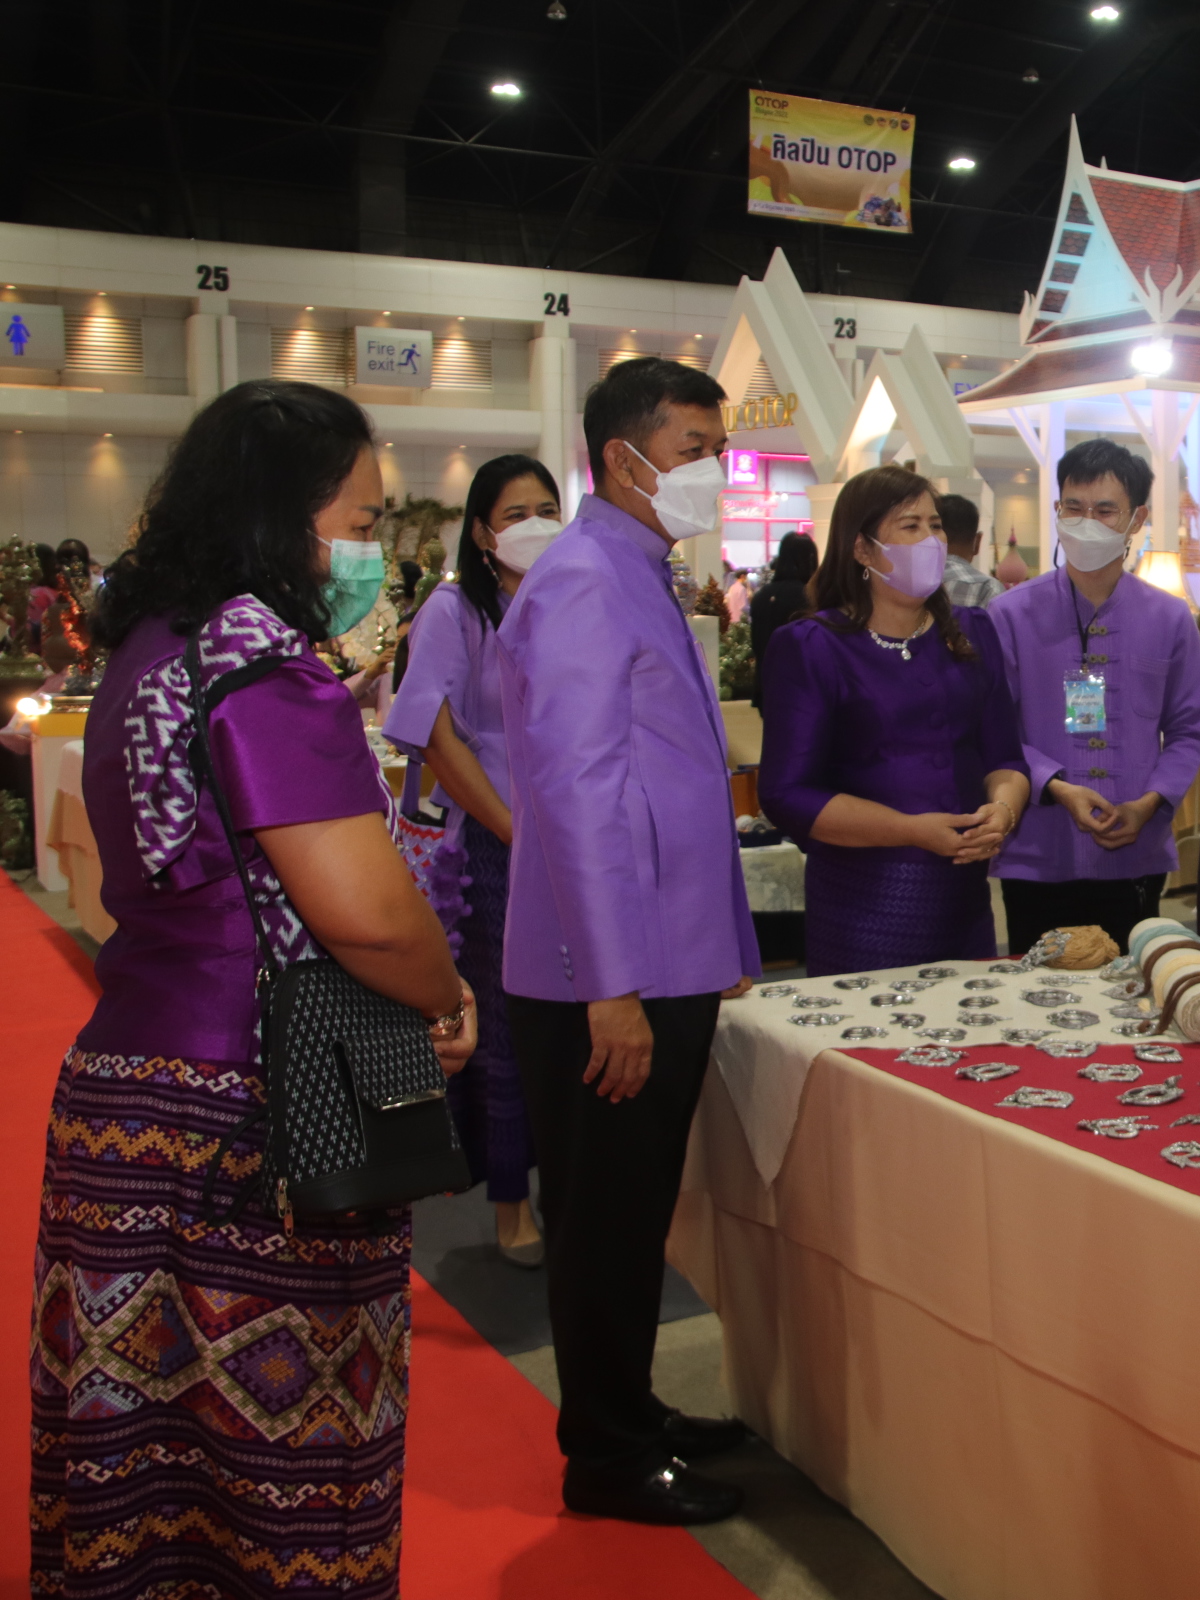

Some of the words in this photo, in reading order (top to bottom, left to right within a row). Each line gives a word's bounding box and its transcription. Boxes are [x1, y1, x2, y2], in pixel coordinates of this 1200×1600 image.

[755, 96, 789, 109] OTOP
[772, 133, 830, 166] ศิลปิน
[837, 146, 897, 173] OTOP
[196, 264, 230, 292] 25
[543, 292, 571, 317] 24
[834, 317, 857, 339] 23
[367, 340, 395, 356] Fire
[368, 357, 394, 371] exit
[744, 392, 799, 431] OTOP
